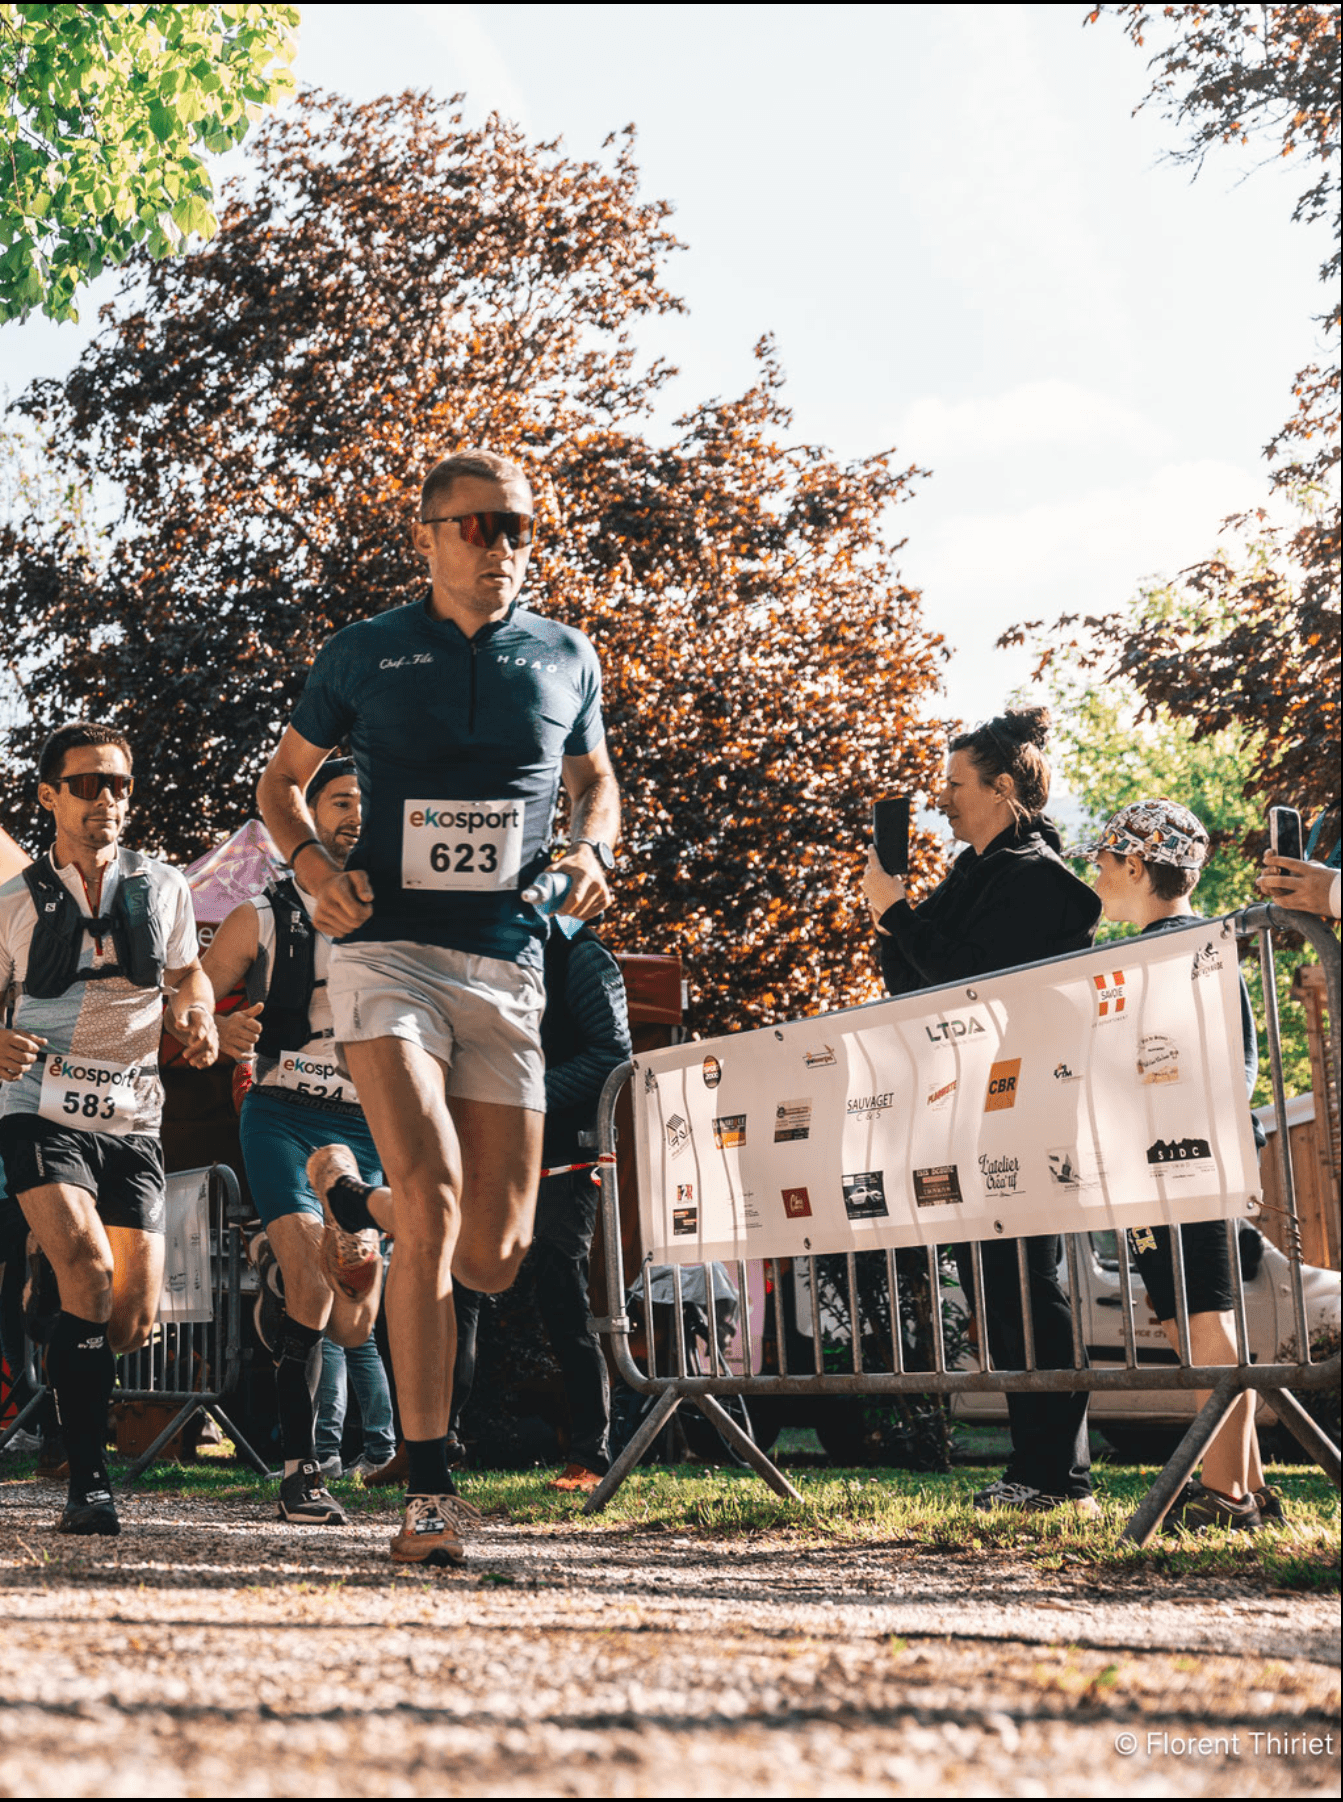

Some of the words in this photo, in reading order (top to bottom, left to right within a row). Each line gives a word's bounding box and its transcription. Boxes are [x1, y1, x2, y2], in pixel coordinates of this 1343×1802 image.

[410, 807, 519, 833] ekosport
[429, 842, 498, 873] 623
[1101, 987, 1124, 1000] SAVOIE
[925, 1016, 985, 1042] LTDA
[49, 1060, 138, 1087] ekosport
[283, 1058, 335, 1079] ekosp
[988, 1077, 1015, 1095] CBR
[63, 1090, 115, 1119] 583
[322, 1100, 362, 1119] COMB
[847, 1092, 894, 1112] SAUVAGET
[1158, 1146, 1199, 1160] SJDC
